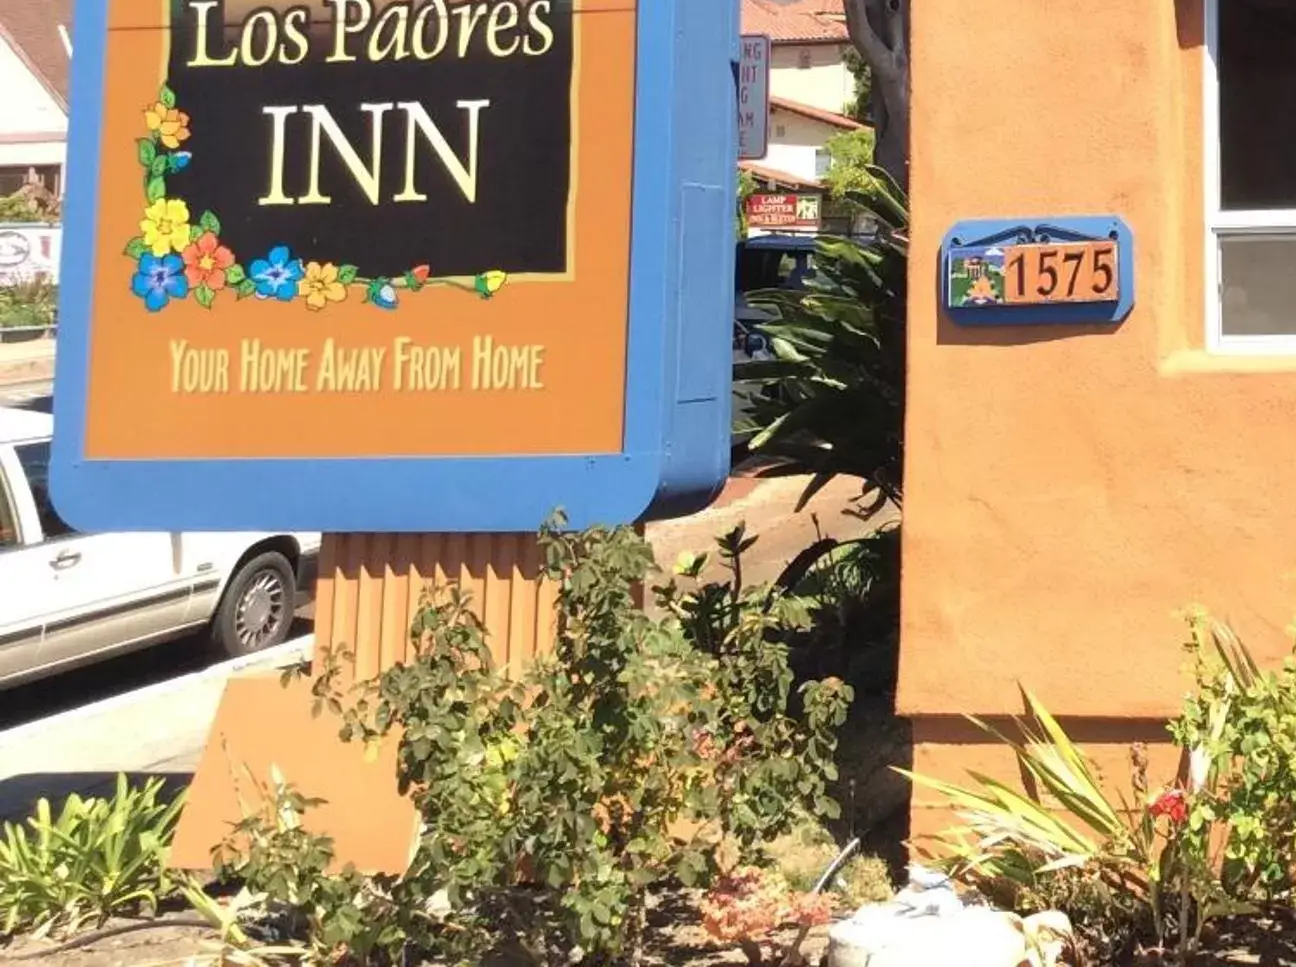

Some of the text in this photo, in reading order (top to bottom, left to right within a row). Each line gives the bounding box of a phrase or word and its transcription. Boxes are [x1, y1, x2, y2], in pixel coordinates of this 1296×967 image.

[186, 0, 309, 68] Los
[258, 98, 490, 206] INN
[1009, 248, 1114, 297] 1575
[169, 334, 545, 393] YOUR HOME AWAY FROM HOME
